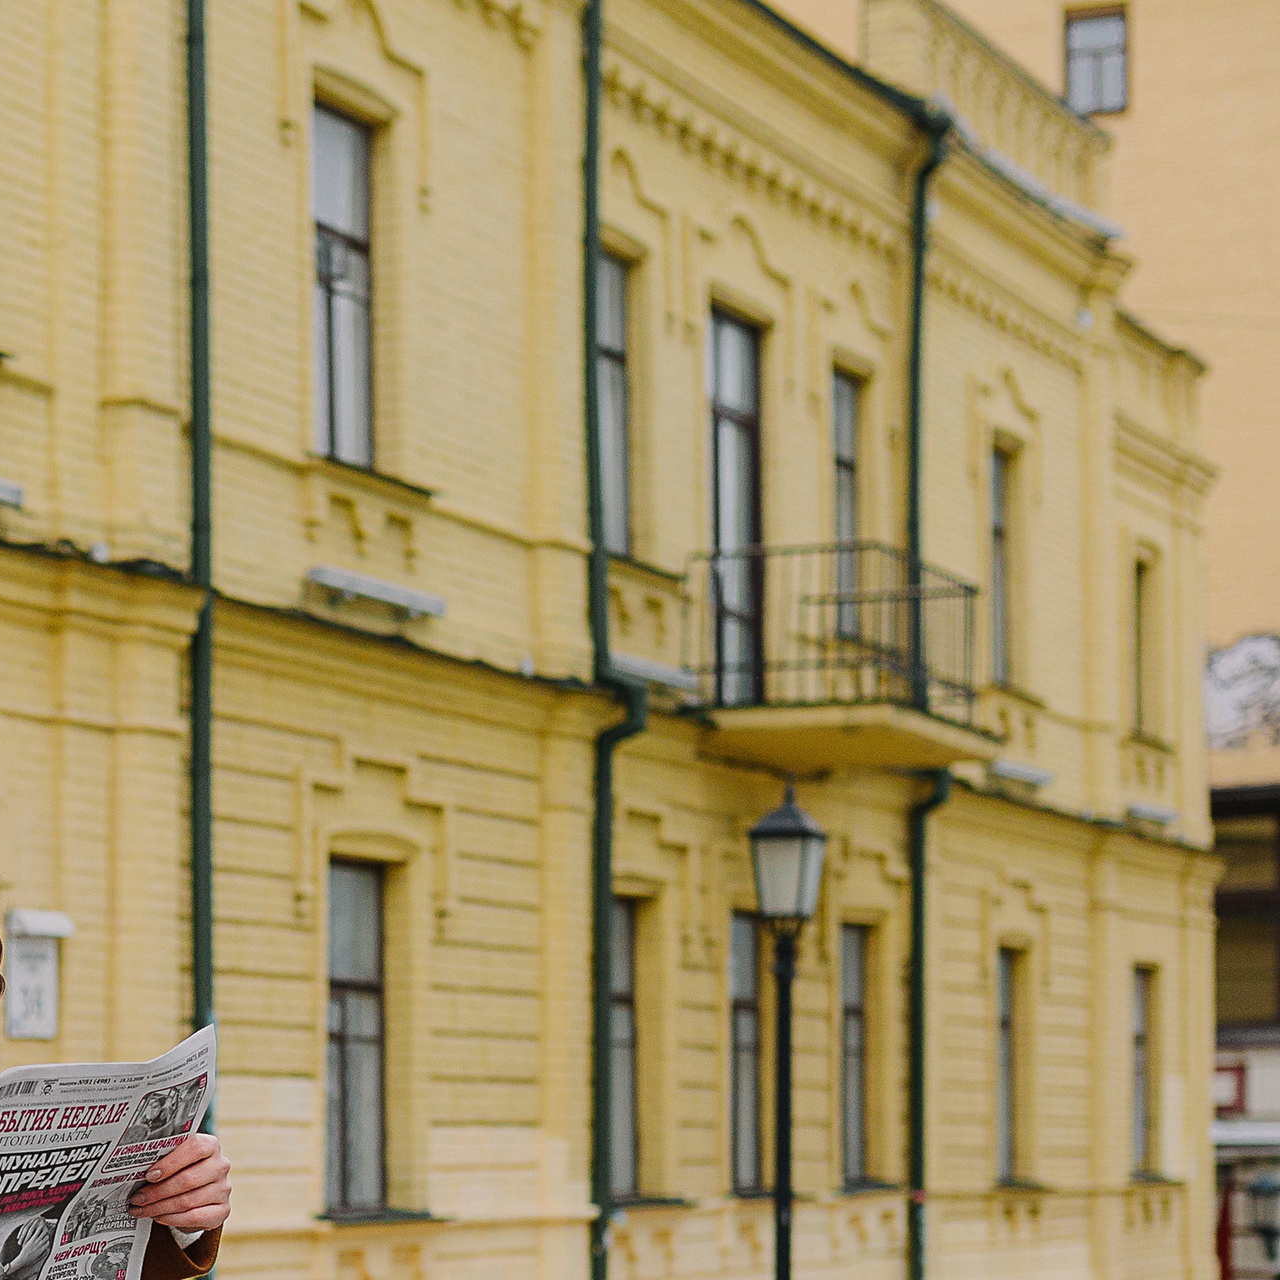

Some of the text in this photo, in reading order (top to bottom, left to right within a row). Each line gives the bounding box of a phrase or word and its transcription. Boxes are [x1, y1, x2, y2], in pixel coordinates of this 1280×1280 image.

[37, 1133, 48, 1145] И
[49, 1129, 93, 1143] ФАКТЫ
[121, 1143, 146, 1156] СНОВА
[95, 1220, 136, 1232] ЗАКАРПАТЬЕ
[61, 1233, 70, 1243] 11
[54, 1241, 107, 1262] ЧЕЙ БОРЩ?
[116, 1269, 126, 1279] 10
